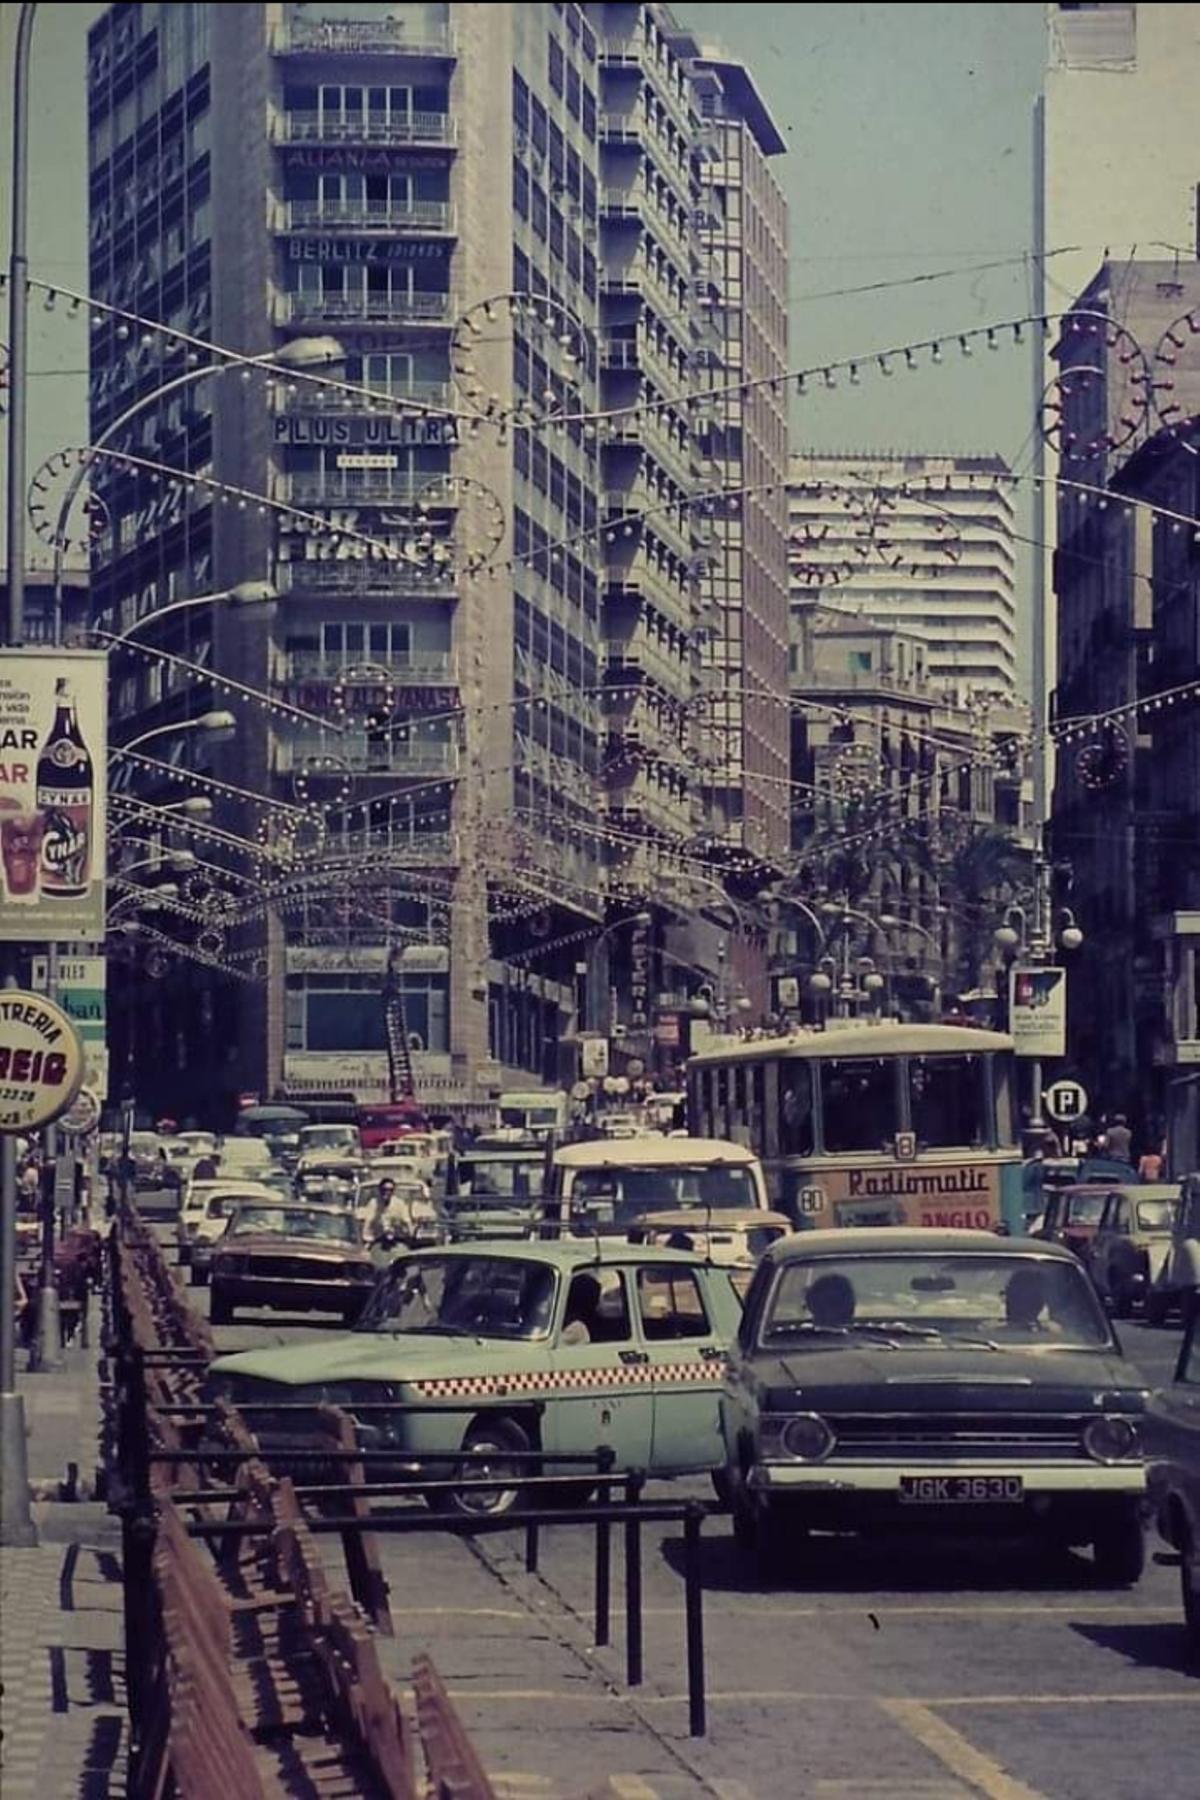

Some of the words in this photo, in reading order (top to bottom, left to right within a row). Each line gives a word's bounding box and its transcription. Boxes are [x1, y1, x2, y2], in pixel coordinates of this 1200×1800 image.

[289, 241, 378, 259] BERLITZ
[274, 418, 349, 441] PLUS
[366, 418, 460, 442] ULTRA
[278, 535, 456, 561] FRANCE
[37, 965, 86, 980] MBLES
[1060, 1091, 1073, 1112] P
[849, 1168, 989, 1196] Radiomatic
[920, 1209, 991, 1229] ANGLO
[902, 1478, 949, 1498] JGK
[957, 1478, 1020, 1498] 363D
